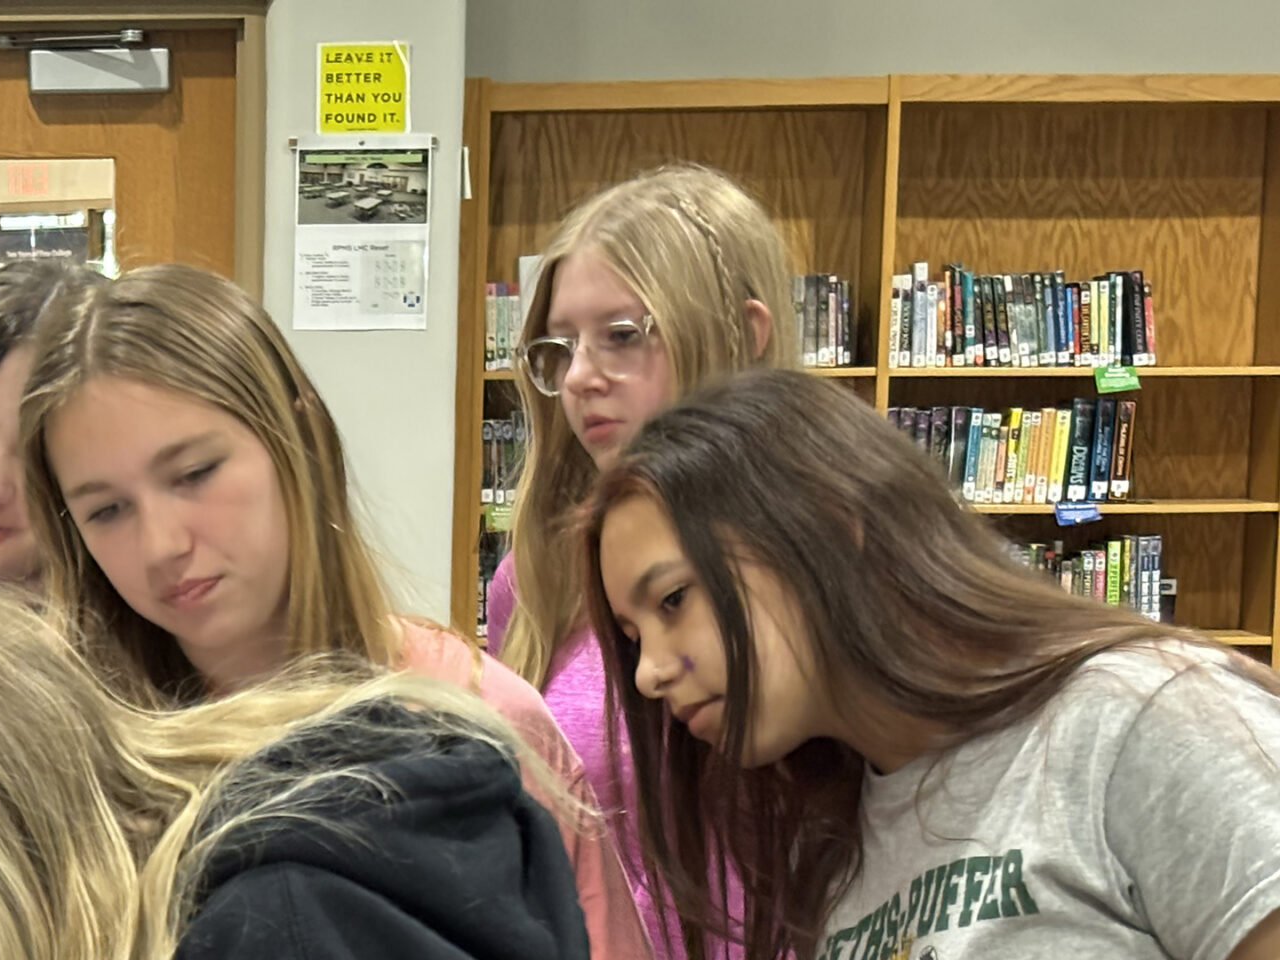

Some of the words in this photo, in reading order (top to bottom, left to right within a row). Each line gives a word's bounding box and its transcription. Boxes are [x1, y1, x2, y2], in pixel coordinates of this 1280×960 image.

[325, 52, 373, 64] LEAVE
[379, 52, 393, 63] IT
[325, 72, 382, 84] BETTER
[325, 92, 366, 104] THAN
[372, 92, 402, 103] YOU
[324, 112, 377, 124] FOUND
[383, 112, 400, 123] IT.
